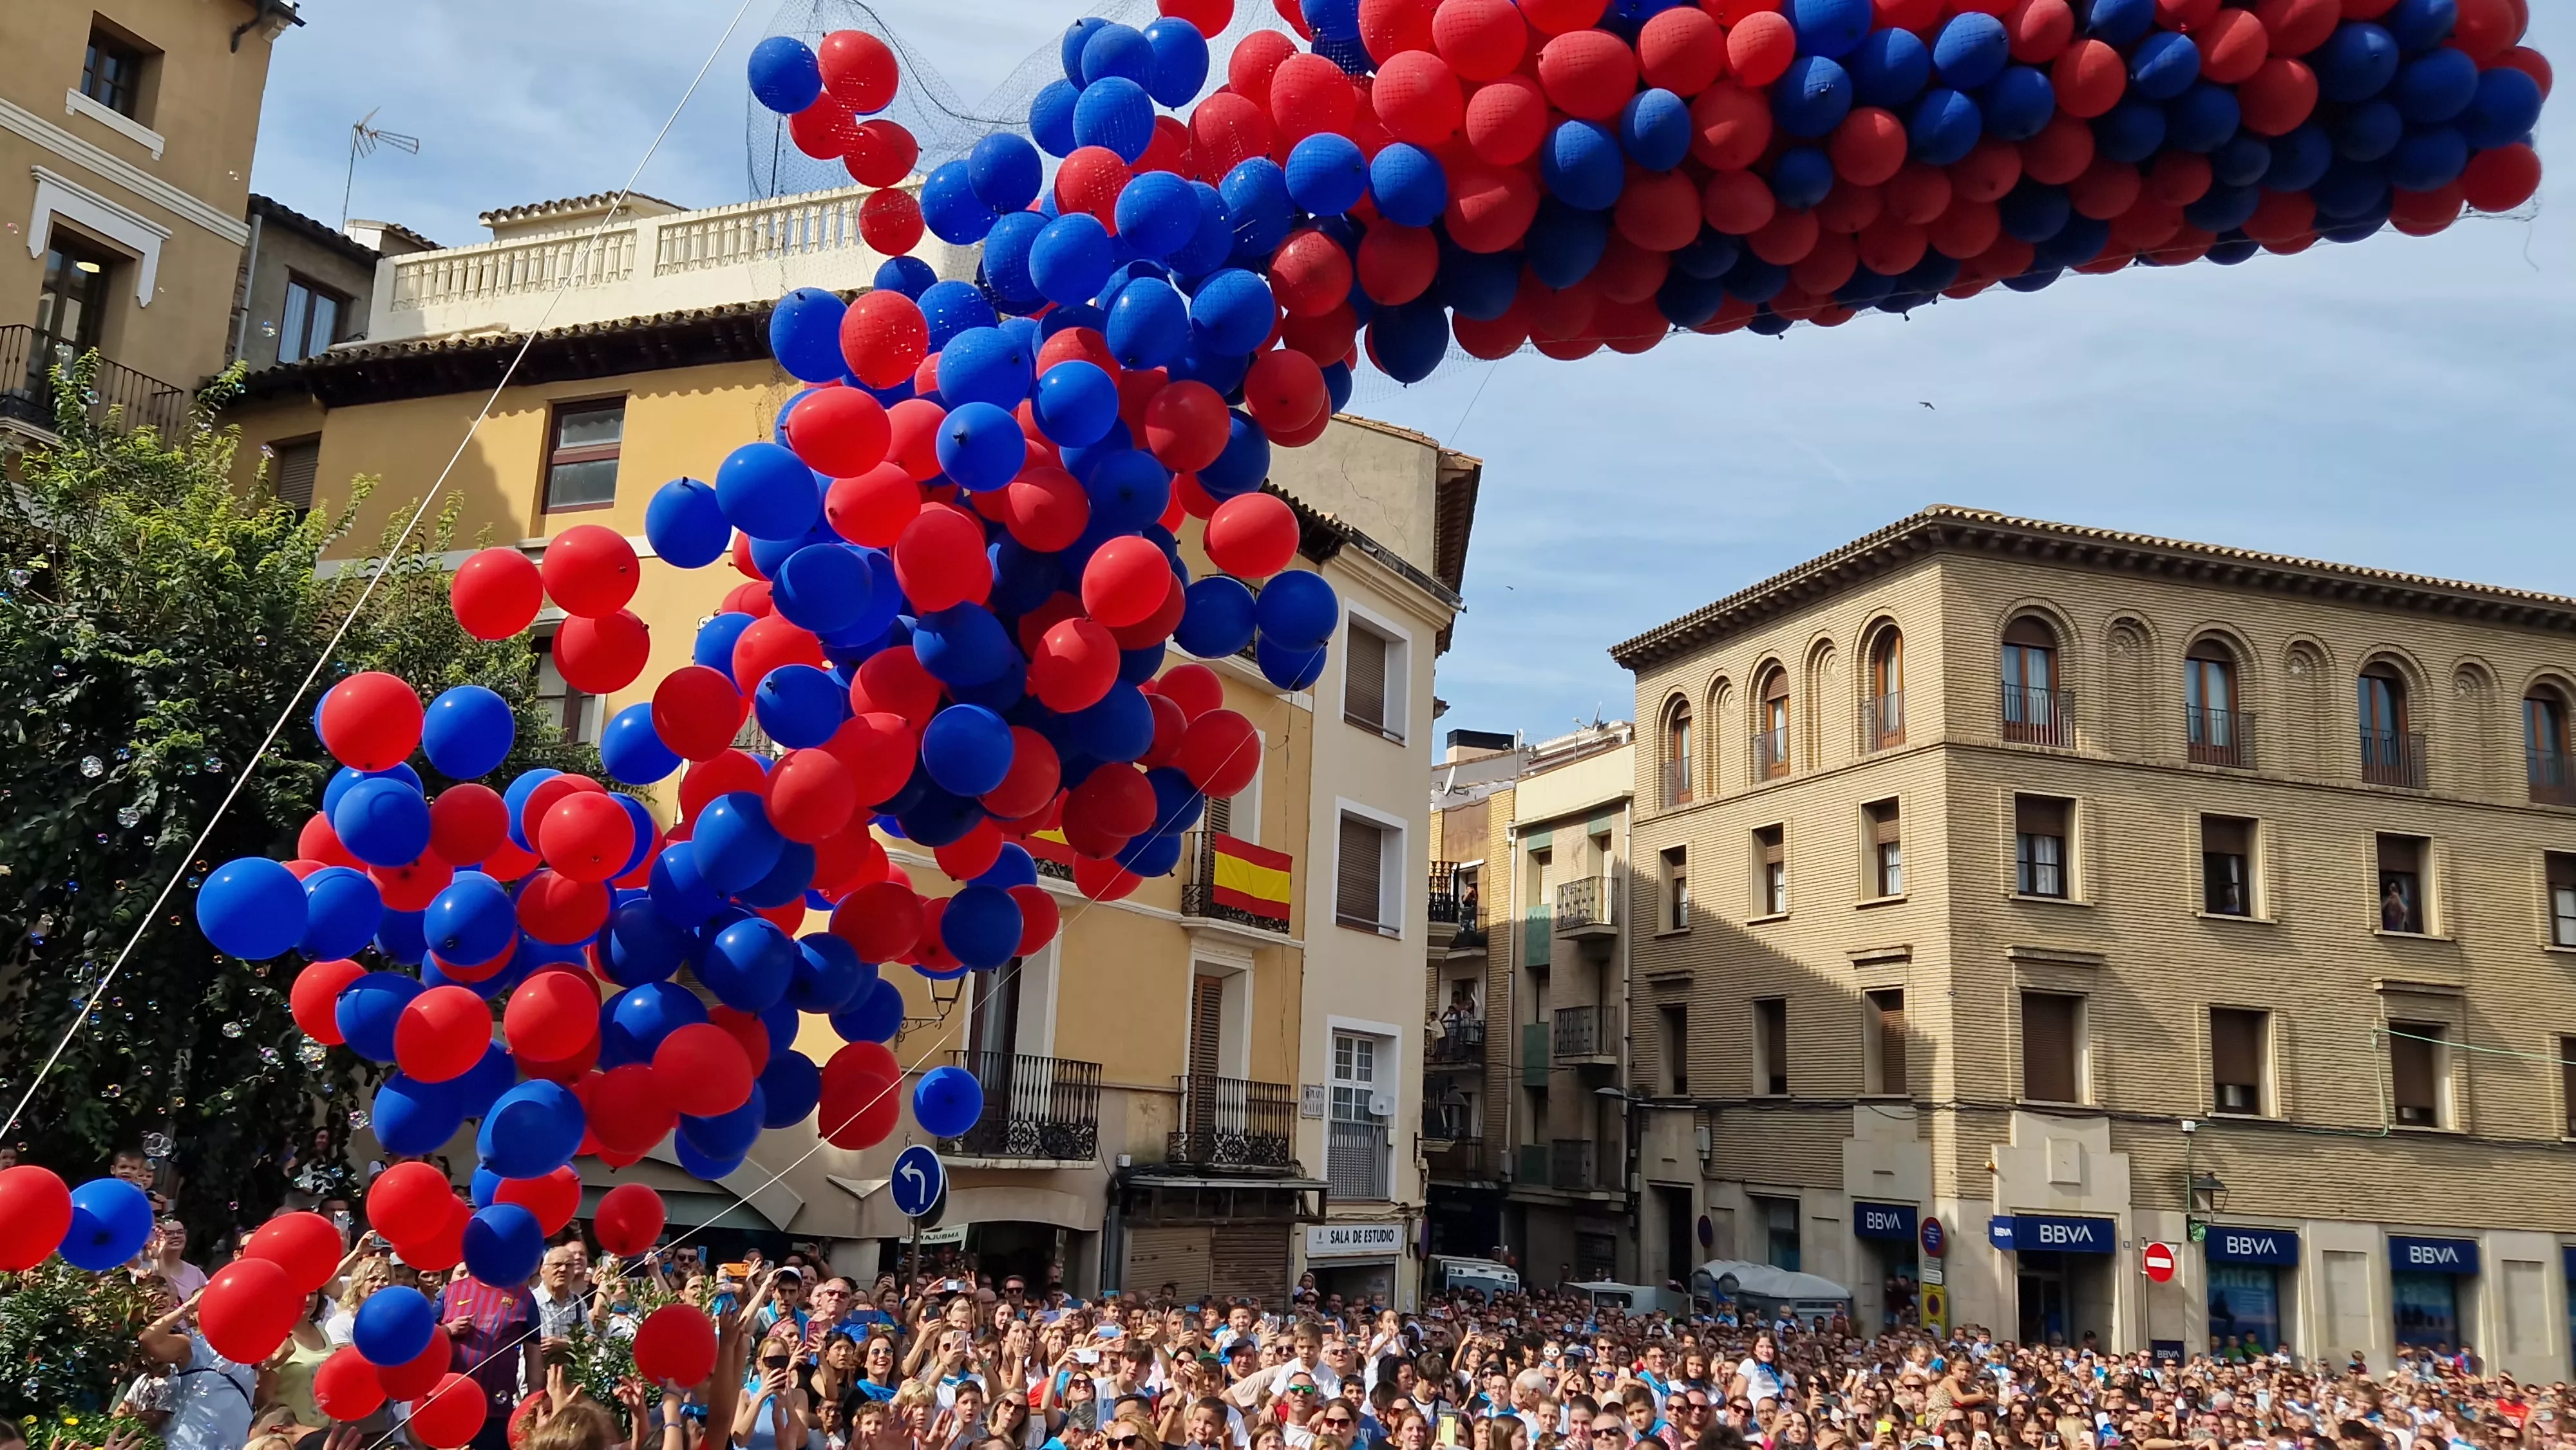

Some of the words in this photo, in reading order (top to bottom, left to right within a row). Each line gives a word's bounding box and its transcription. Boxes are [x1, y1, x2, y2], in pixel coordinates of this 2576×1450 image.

[1866, 1211, 1902, 1230] BBVA
[1330, 1230, 1350, 1244] SALA
[1353, 1230, 1362, 1243] DE
[1364, 1229, 1394, 1243] ESTUDIO
[1994, 1226, 2012, 1238] BBVA
[2040, 1225, 2094, 1243] BBVA
[2226, 1236, 2278, 1256] BBVA
[2409, 1245, 2460, 1265] BBVA
[2157, 1350, 2180, 1359] BBVA
